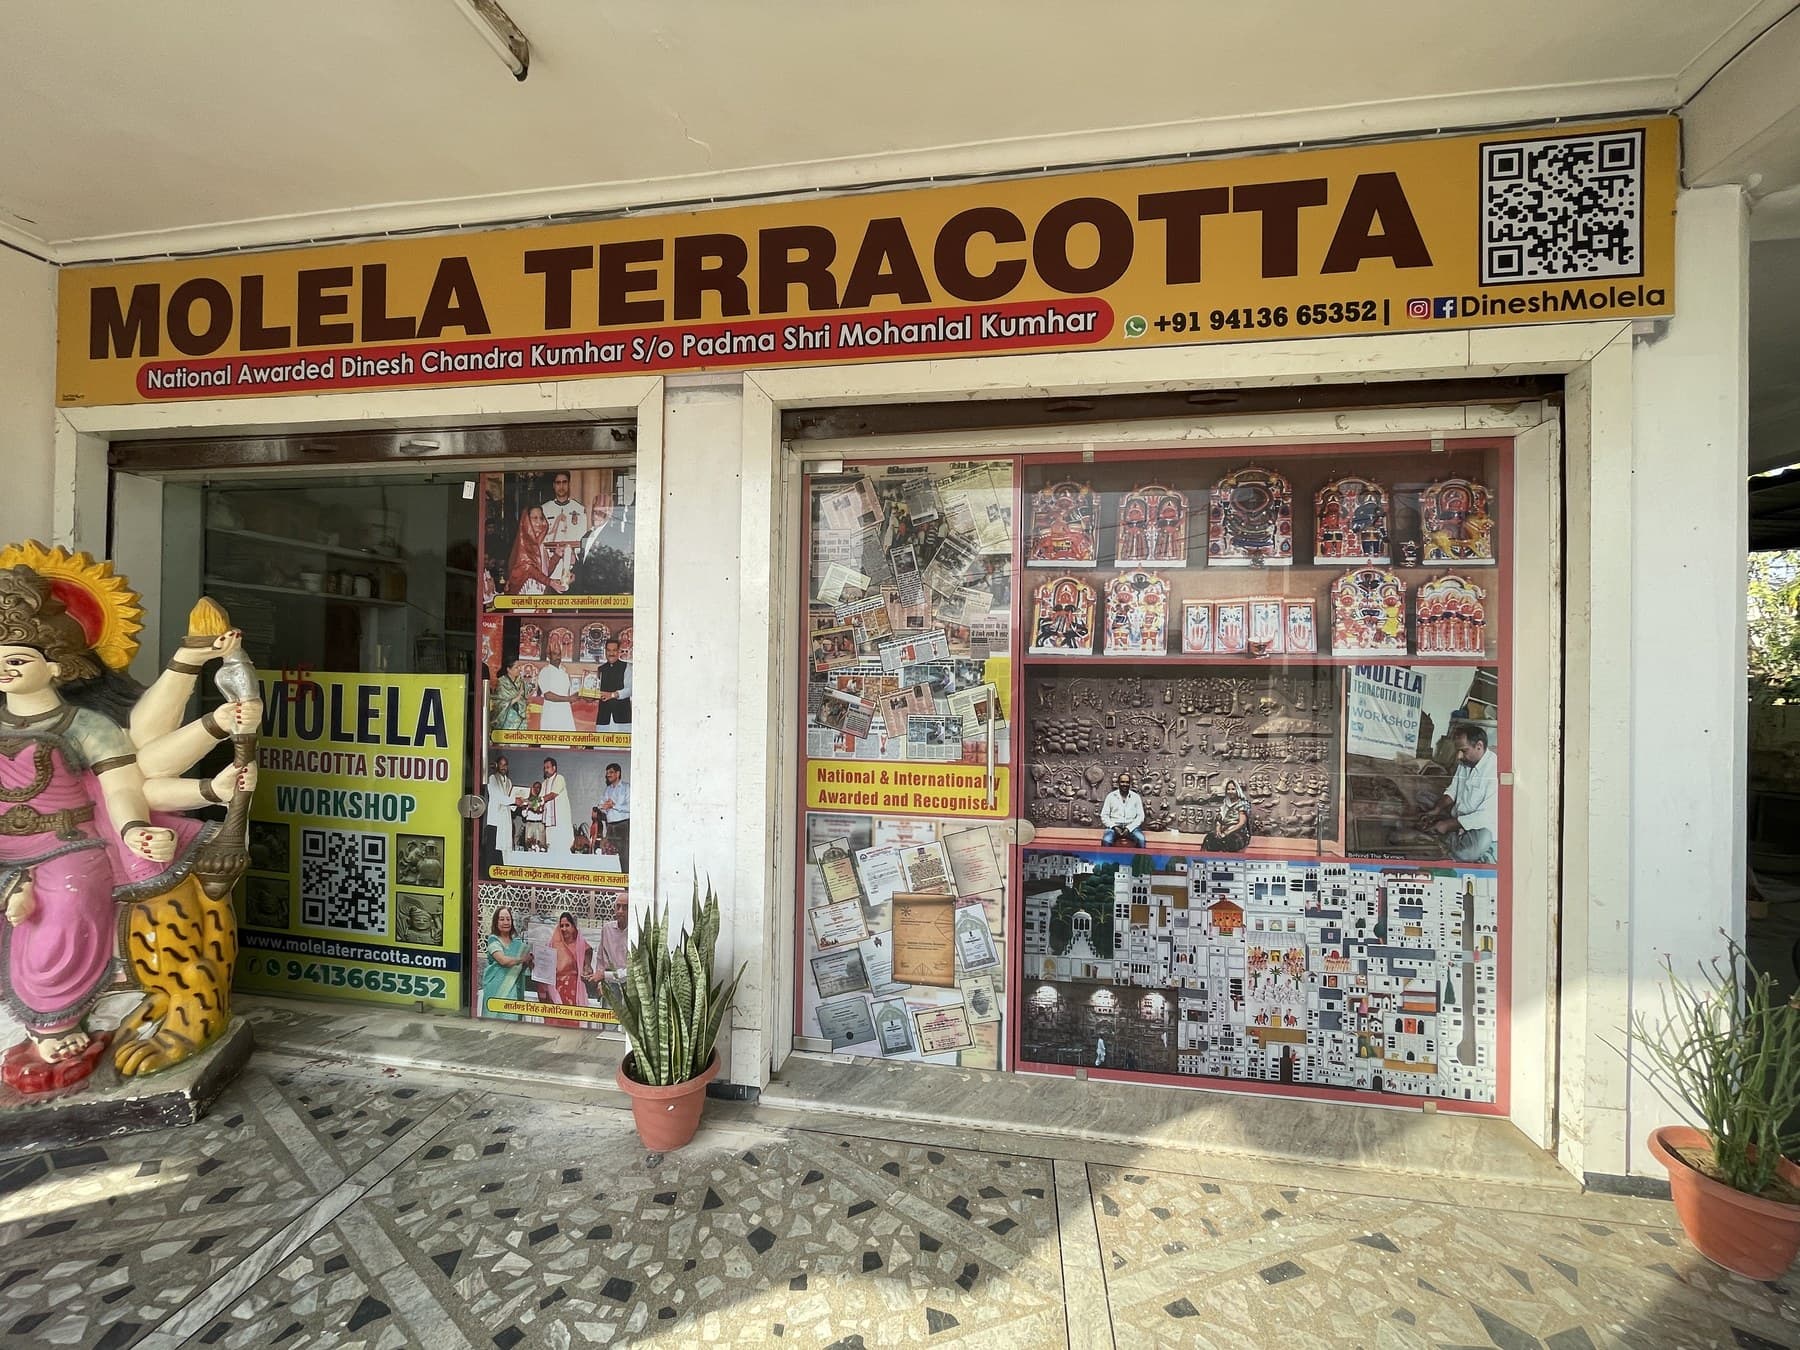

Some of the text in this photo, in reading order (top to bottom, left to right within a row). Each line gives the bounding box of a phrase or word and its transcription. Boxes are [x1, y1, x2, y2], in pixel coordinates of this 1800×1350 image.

[89, 172, 1434, 360] MOLELA TERRACOTTA
[1154, 308, 1201, 333] +91
[1209, 307, 1289, 331] 94136
[1296, 300, 1378, 326] 65352
[1461, 286, 1666, 318] DineshMolela
[147, 308, 1098, 391] National Awarded Dinesh Chandra Kumhar S/o Padma Shri Mohanlal Kumhar
[534, 598, 557, 608] पुरस्कार
[570, 596, 600, 606] सम्मानित
[1352, 706, 1418, 729] WORKSHOP
[534, 734, 557, 743] पुरस्कार
[571, 733, 601, 744] सम्मानित
[257, 747, 449, 782] ERRACOTTA STUDIO
[817, 767, 1000, 791] National & Internationaly
[276, 786, 415, 822] WORKSHOP
[818, 789, 879, 806] Awarded
[883, 793, 909, 808] and
[246, 934, 447, 969] www.molelaterracotta.com
[287, 960, 446, 999] 9413665352
